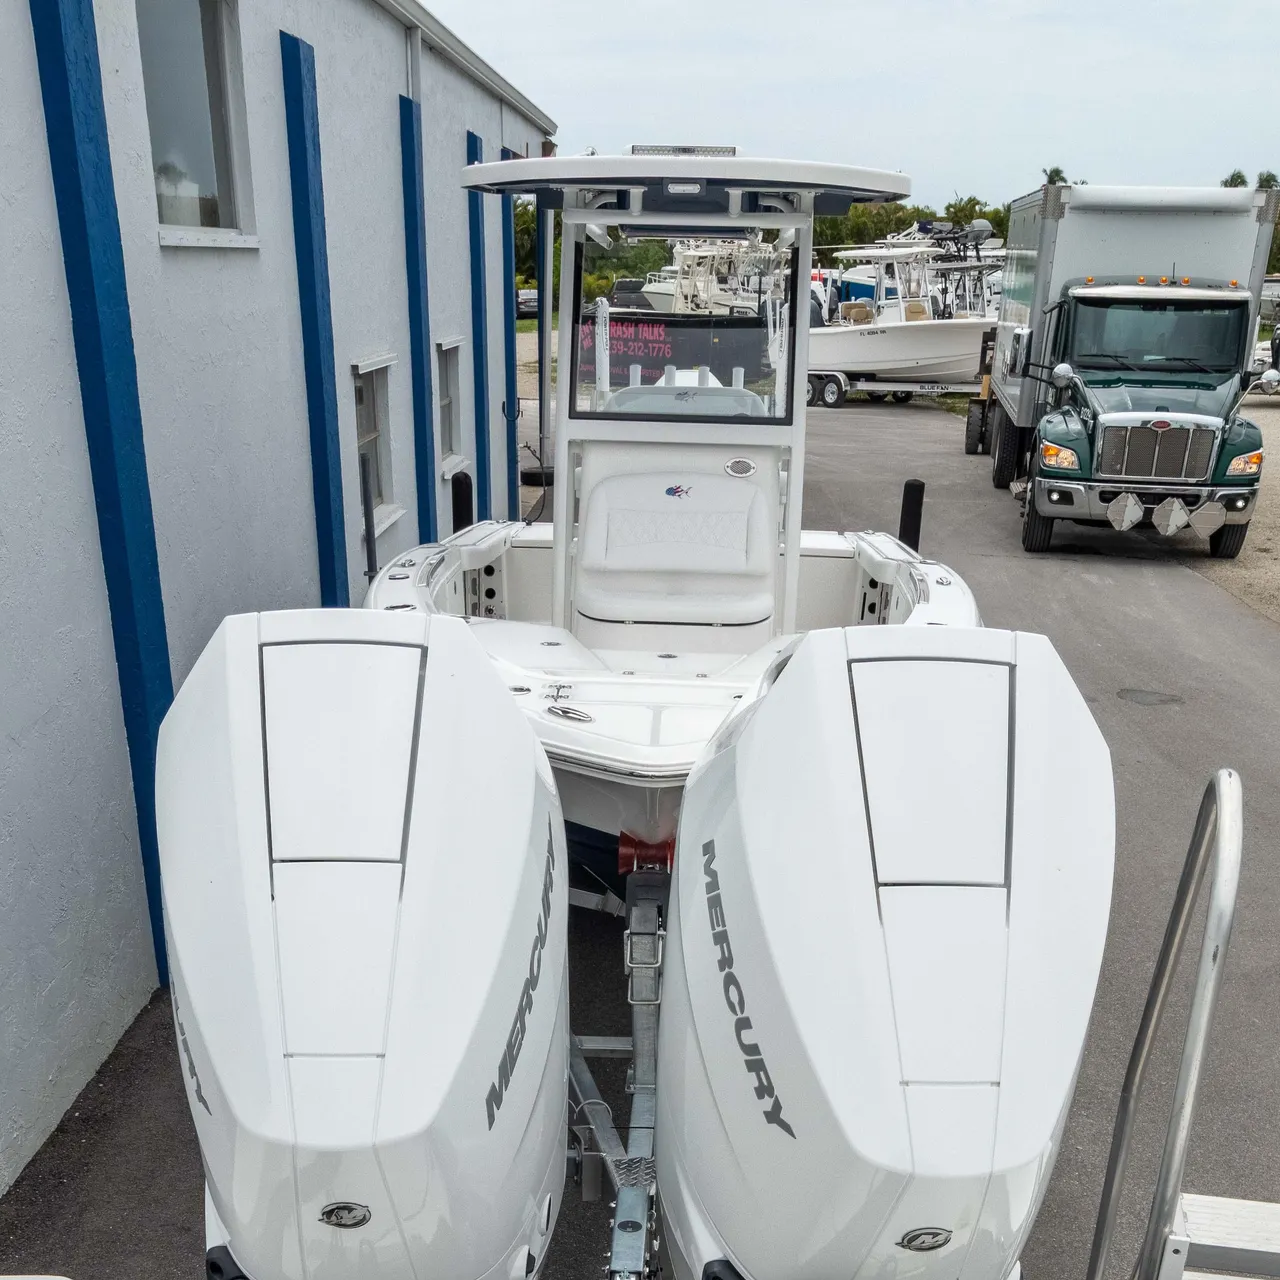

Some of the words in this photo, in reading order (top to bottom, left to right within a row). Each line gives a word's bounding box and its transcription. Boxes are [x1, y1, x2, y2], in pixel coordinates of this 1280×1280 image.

[609, 321, 635, 339] RASH
[638, 322, 665, 341] TALKS
[609, 341, 672, 358] 39-212-1776
[485, 811, 555, 1131] MERCURY
[702, 839, 797, 1140] MERCURY
